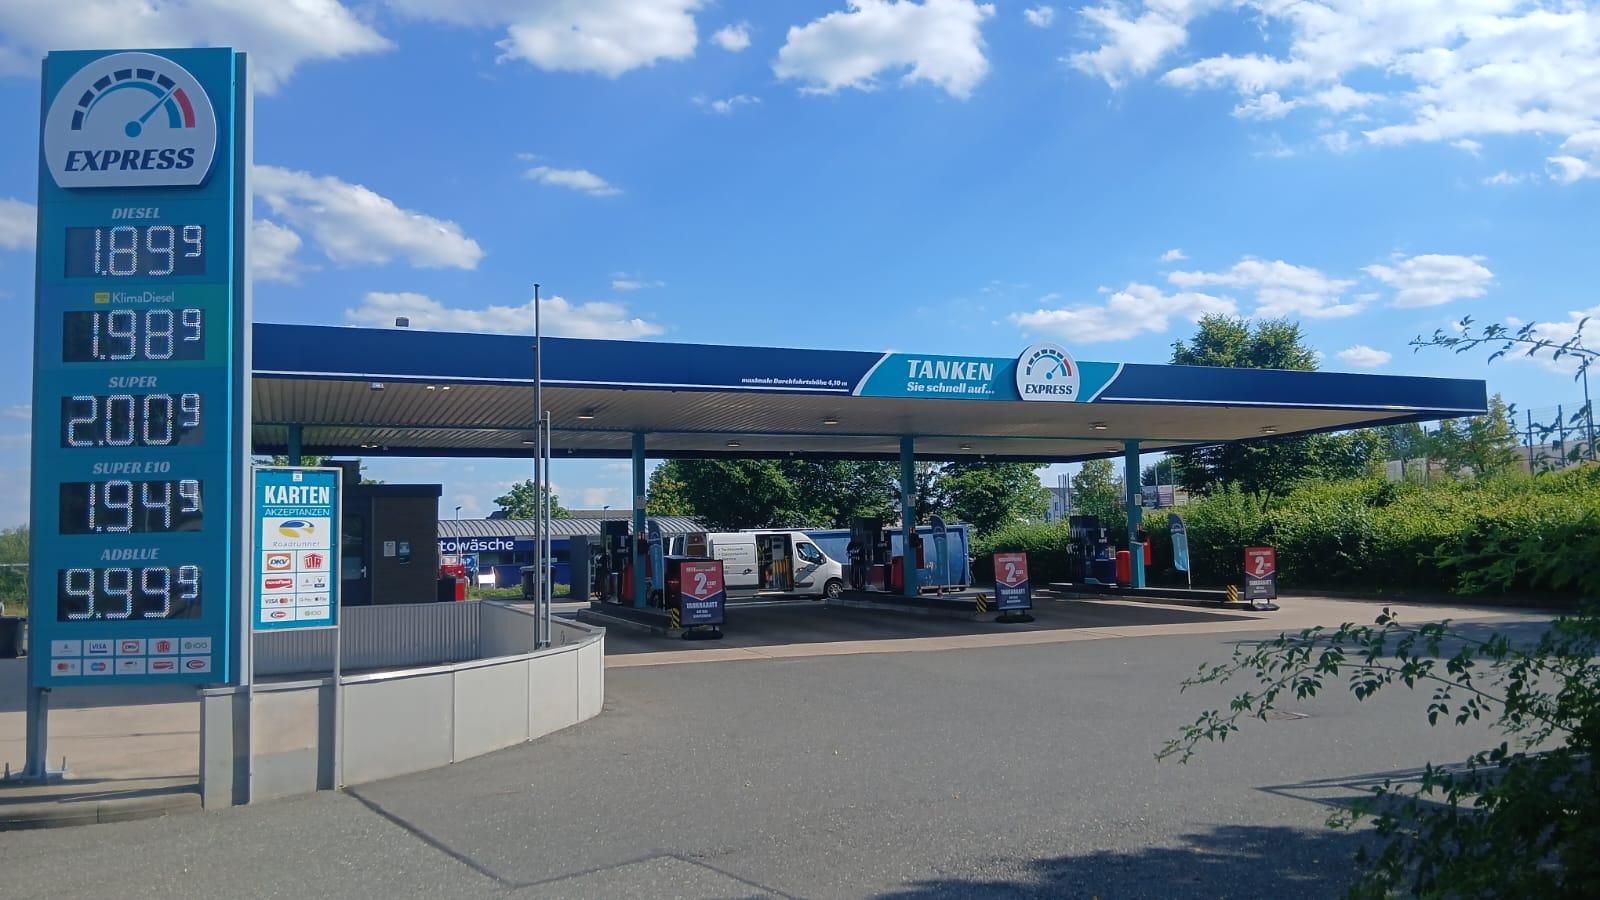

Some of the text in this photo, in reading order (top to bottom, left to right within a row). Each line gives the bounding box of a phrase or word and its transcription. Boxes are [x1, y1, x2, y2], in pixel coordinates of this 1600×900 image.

[64, 147, 195, 172] EXPRESS
[111, 207, 161, 219] DIESEL
[112, 291, 175, 304] KlimaDiesel
[907, 359, 994, 381] TANKEN
[108, 376, 157, 388] SUPER
[907, 382, 995, 394] Sie schnell auf...
[1024, 383, 1074, 395] EXPRESS
[92, 461, 171, 475] SUPER E10
[264, 485, 330, 504] KARTEN
[264, 508, 330, 516] AKZEPTANZEN
[100, 548, 160, 561] ADBLUE
[1255, 556, 1265, 574] 2
[1005, 562, 1017, 582] 2
[694, 572, 708, 596] 2
[91, 642, 107, 650] VISA
